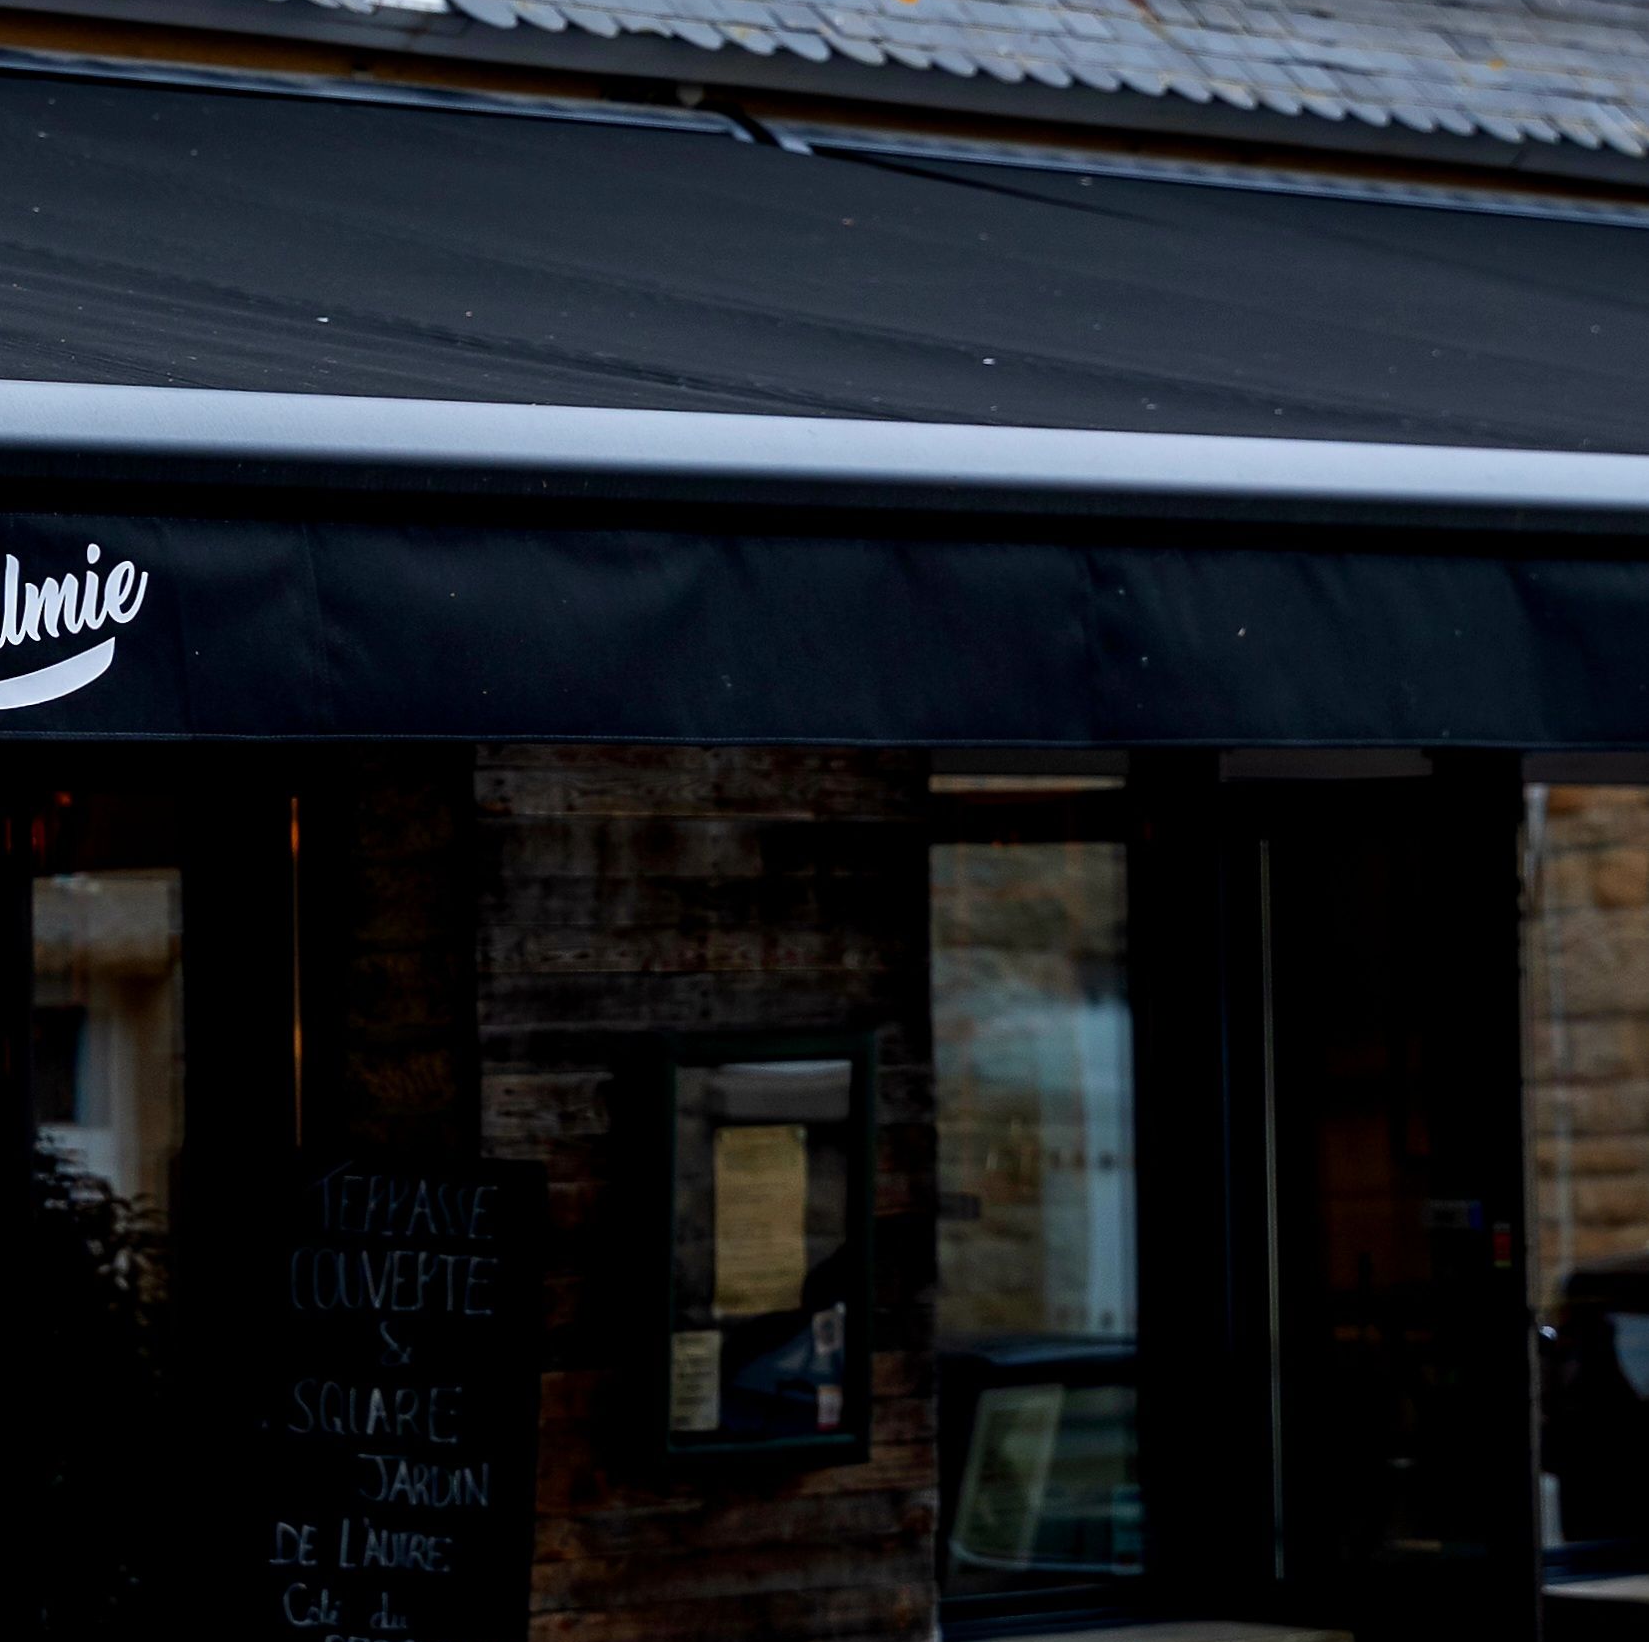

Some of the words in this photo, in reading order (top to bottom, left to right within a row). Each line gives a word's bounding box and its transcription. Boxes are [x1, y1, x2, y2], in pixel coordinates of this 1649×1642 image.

[357, 1453, 490, 1509] JARDIN
[269, 1520, 318, 1567] DE
[369, 1591, 409, 1630] du
